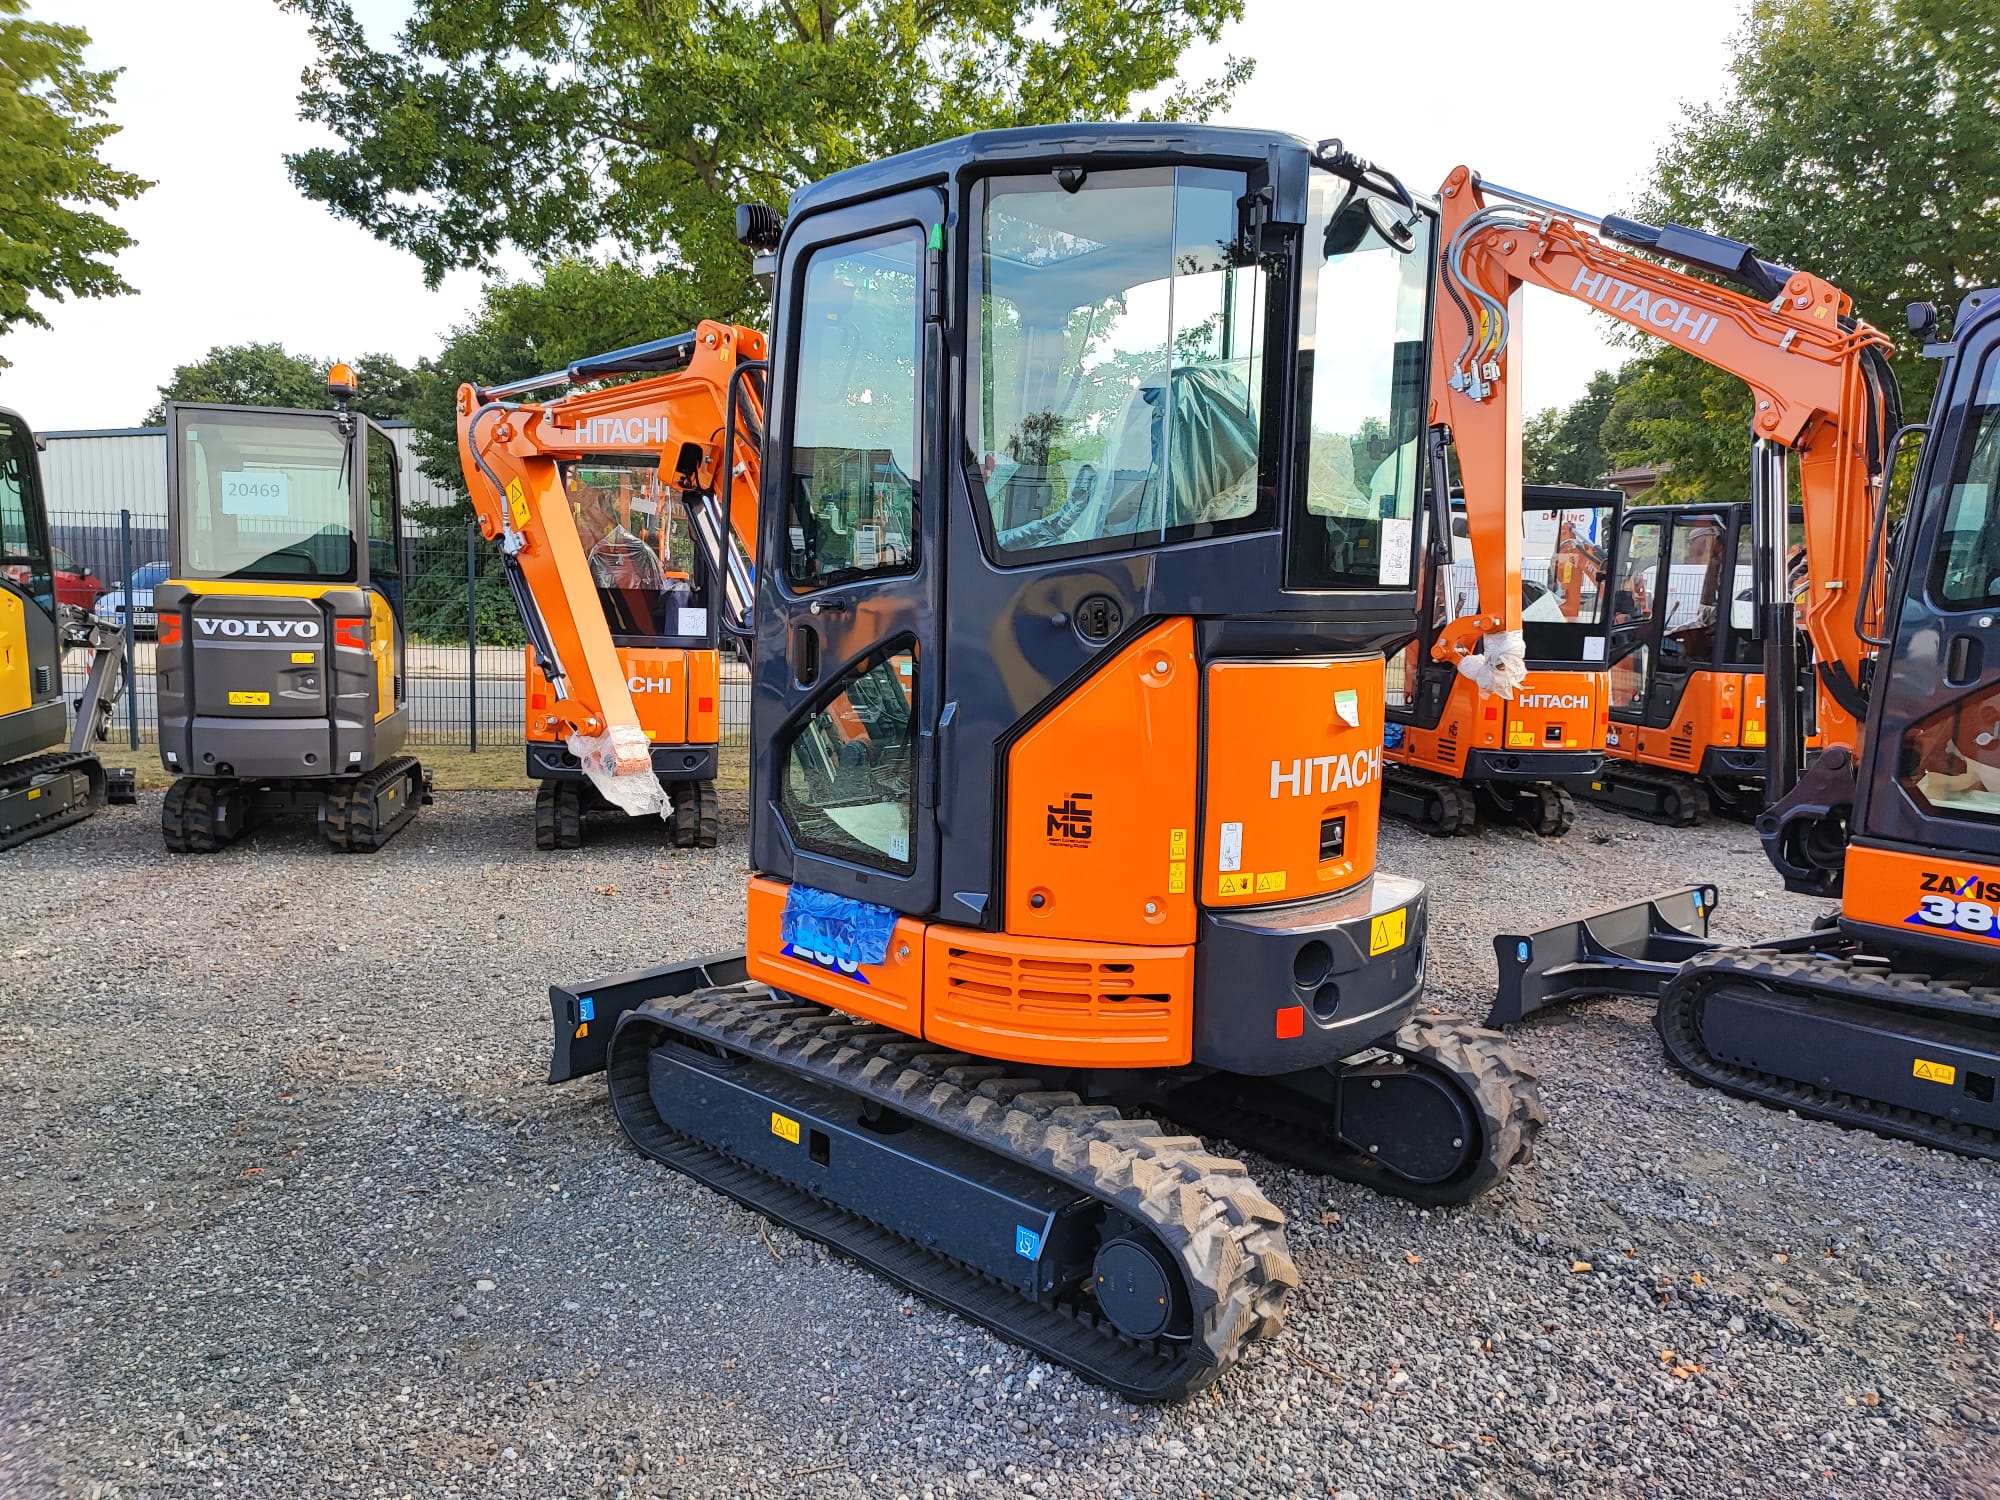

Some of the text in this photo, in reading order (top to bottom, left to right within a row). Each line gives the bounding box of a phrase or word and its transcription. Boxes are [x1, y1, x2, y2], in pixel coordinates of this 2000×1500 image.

[1570, 266, 1719, 345] HITACHI
[575, 416, 668, 444] HITACHI
[228, 483, 280, 498] 20469
[1542, 512, 1585, 522] DING
[194, 618, 319, 638] VOLVO
[1519, 694, 1589, 709] HITACHI
[1270, 745, 1381, 799] HITACHI
[1920, 872, 2000, 902] ZAXIS
[1918, 895, 2000, 931] 38
